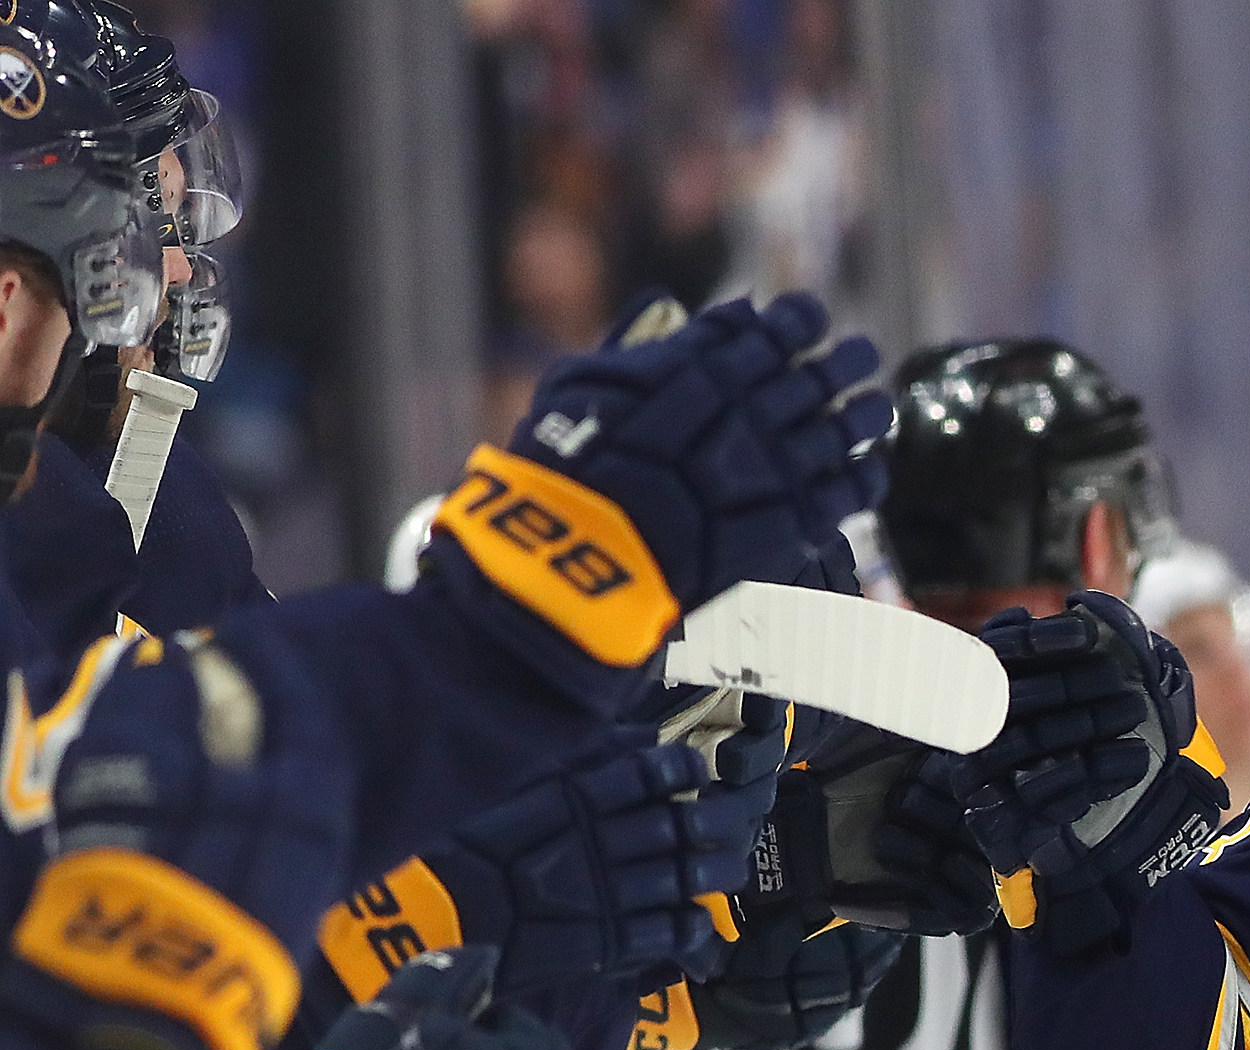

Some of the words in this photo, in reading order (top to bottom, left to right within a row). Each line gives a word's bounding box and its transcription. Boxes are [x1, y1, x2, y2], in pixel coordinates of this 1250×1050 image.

[769, 844, 782, 872] PRO
[1146, 820, 1212, 888] CCM
[1158, 829, 1184, 859] PRO
